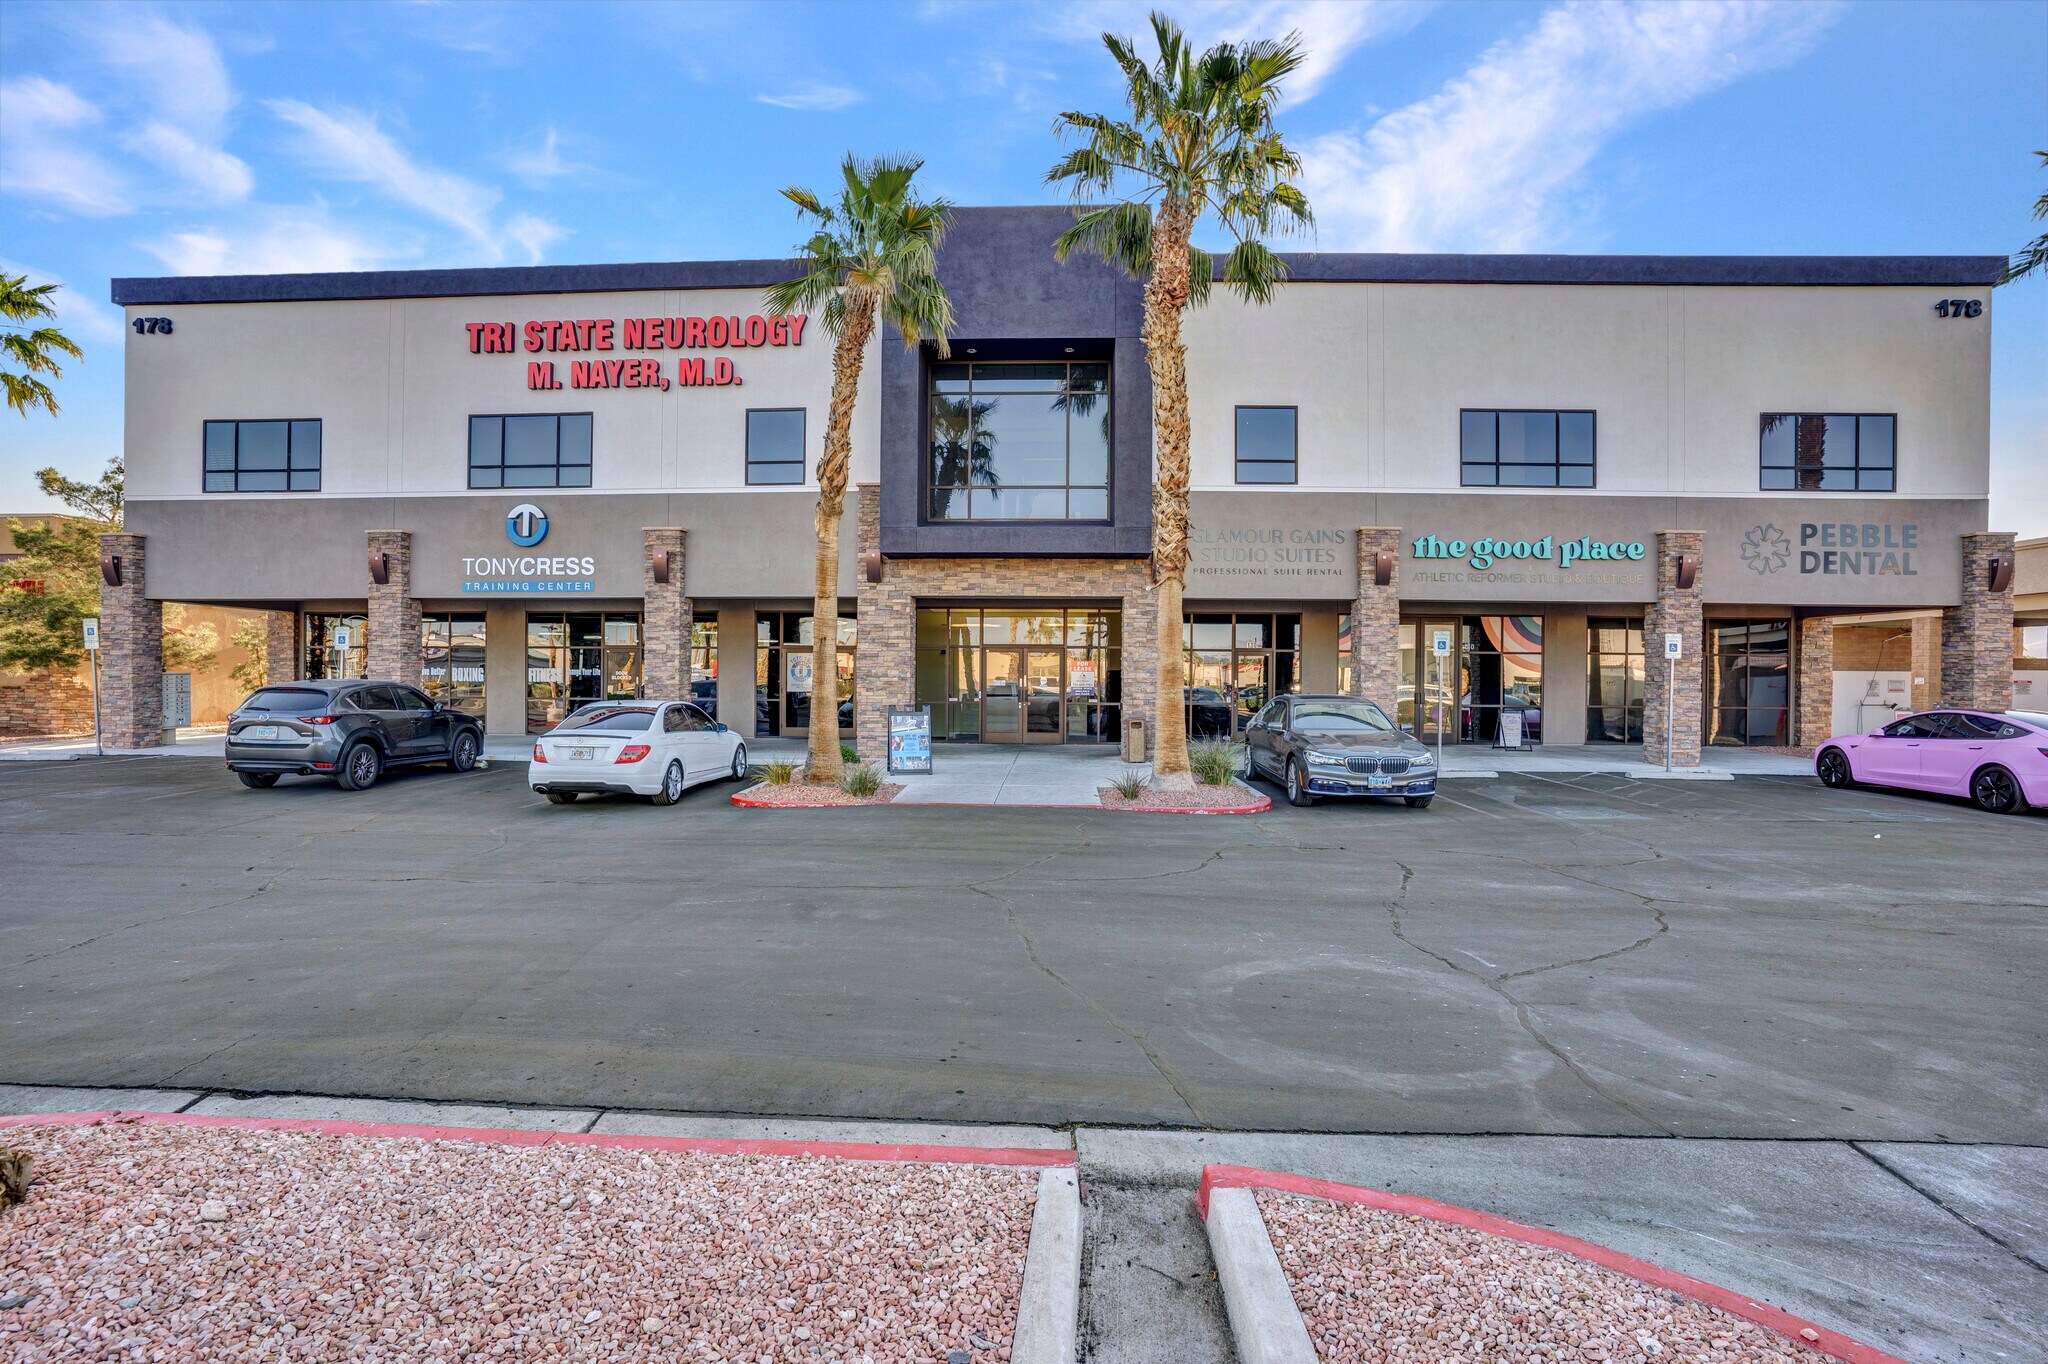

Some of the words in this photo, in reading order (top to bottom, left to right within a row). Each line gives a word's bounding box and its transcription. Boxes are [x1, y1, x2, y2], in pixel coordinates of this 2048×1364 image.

[1935, 299, 1983, 318] 178
[132, 317, 173, 335] 178
[465, 322, 516, 354] TRI
[523, 319, 615, 352] STATE
[623, 315, 808, 350] NEUROLOGY
[527, 361, 562, 390] M.
[570, 358, 670, 392] NAYER,
[678, 357, 742, 387] M.D.
[1192, 529, 1284, 544] GLAMOUR
[1289, 529, 1346, 544] GAINS
[1800, 523, 1918, 548] PEBBLE
[1201, 547, 1269, 563] STUDIO
[1274, 548, 1336, 563] SUITES
[1412, 534, 1467, 559] the
[1469, 535, 1553, 570] good
[1559, 536, 1645, 568] place
[462, 557, 595, 576] TONYCRESS
[1193, 567, 1269, 576] PROFESSIONAL
[1274, 568, 1302, 576] SUITE
[1307, 568, 1344, 576] RENTAL
[1800, 551, 1918, 576] DENTAL
[466, 582, 530, 591] TRAINING
[537, 582, 591, 591] CENTER
[1412, 572, 1464, 583] ATHLETIC
[1467, 572, 1526, 584] REFORMER
[1530, 573, 1571, 584] STUDIO
[1574, 575, 1582, 583] &
[1586, 574, 1643, 585] BOUTIQUE
[452, 667, 485, 682] BOXING
[527, 668, 564, 682] FITNESS
